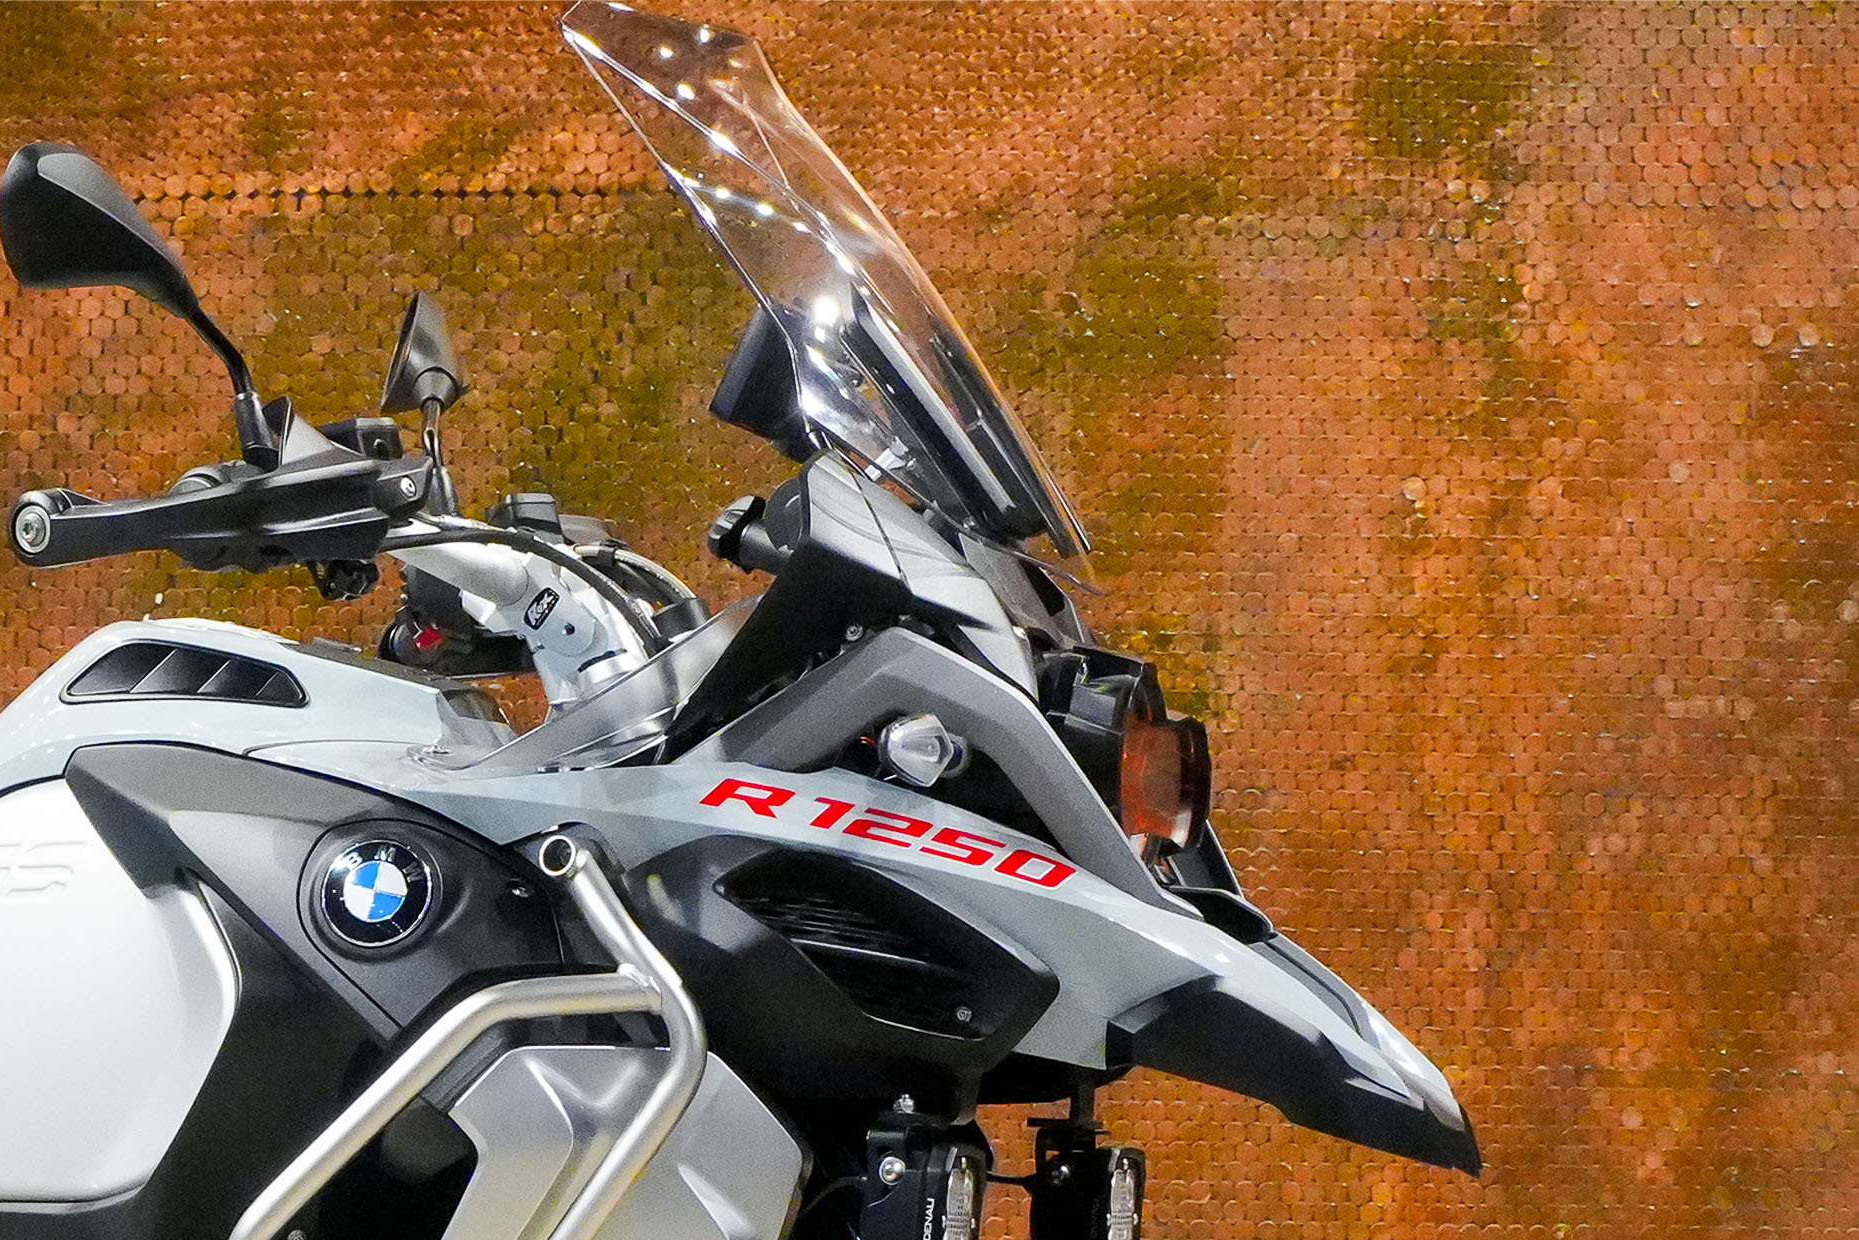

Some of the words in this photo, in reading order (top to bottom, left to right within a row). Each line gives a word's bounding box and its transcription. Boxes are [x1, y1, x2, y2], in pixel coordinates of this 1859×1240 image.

[341, 843, 425, 883] BMW
[698, 777, 797, 820] R
[808, 796, 1078, 889] 1250
